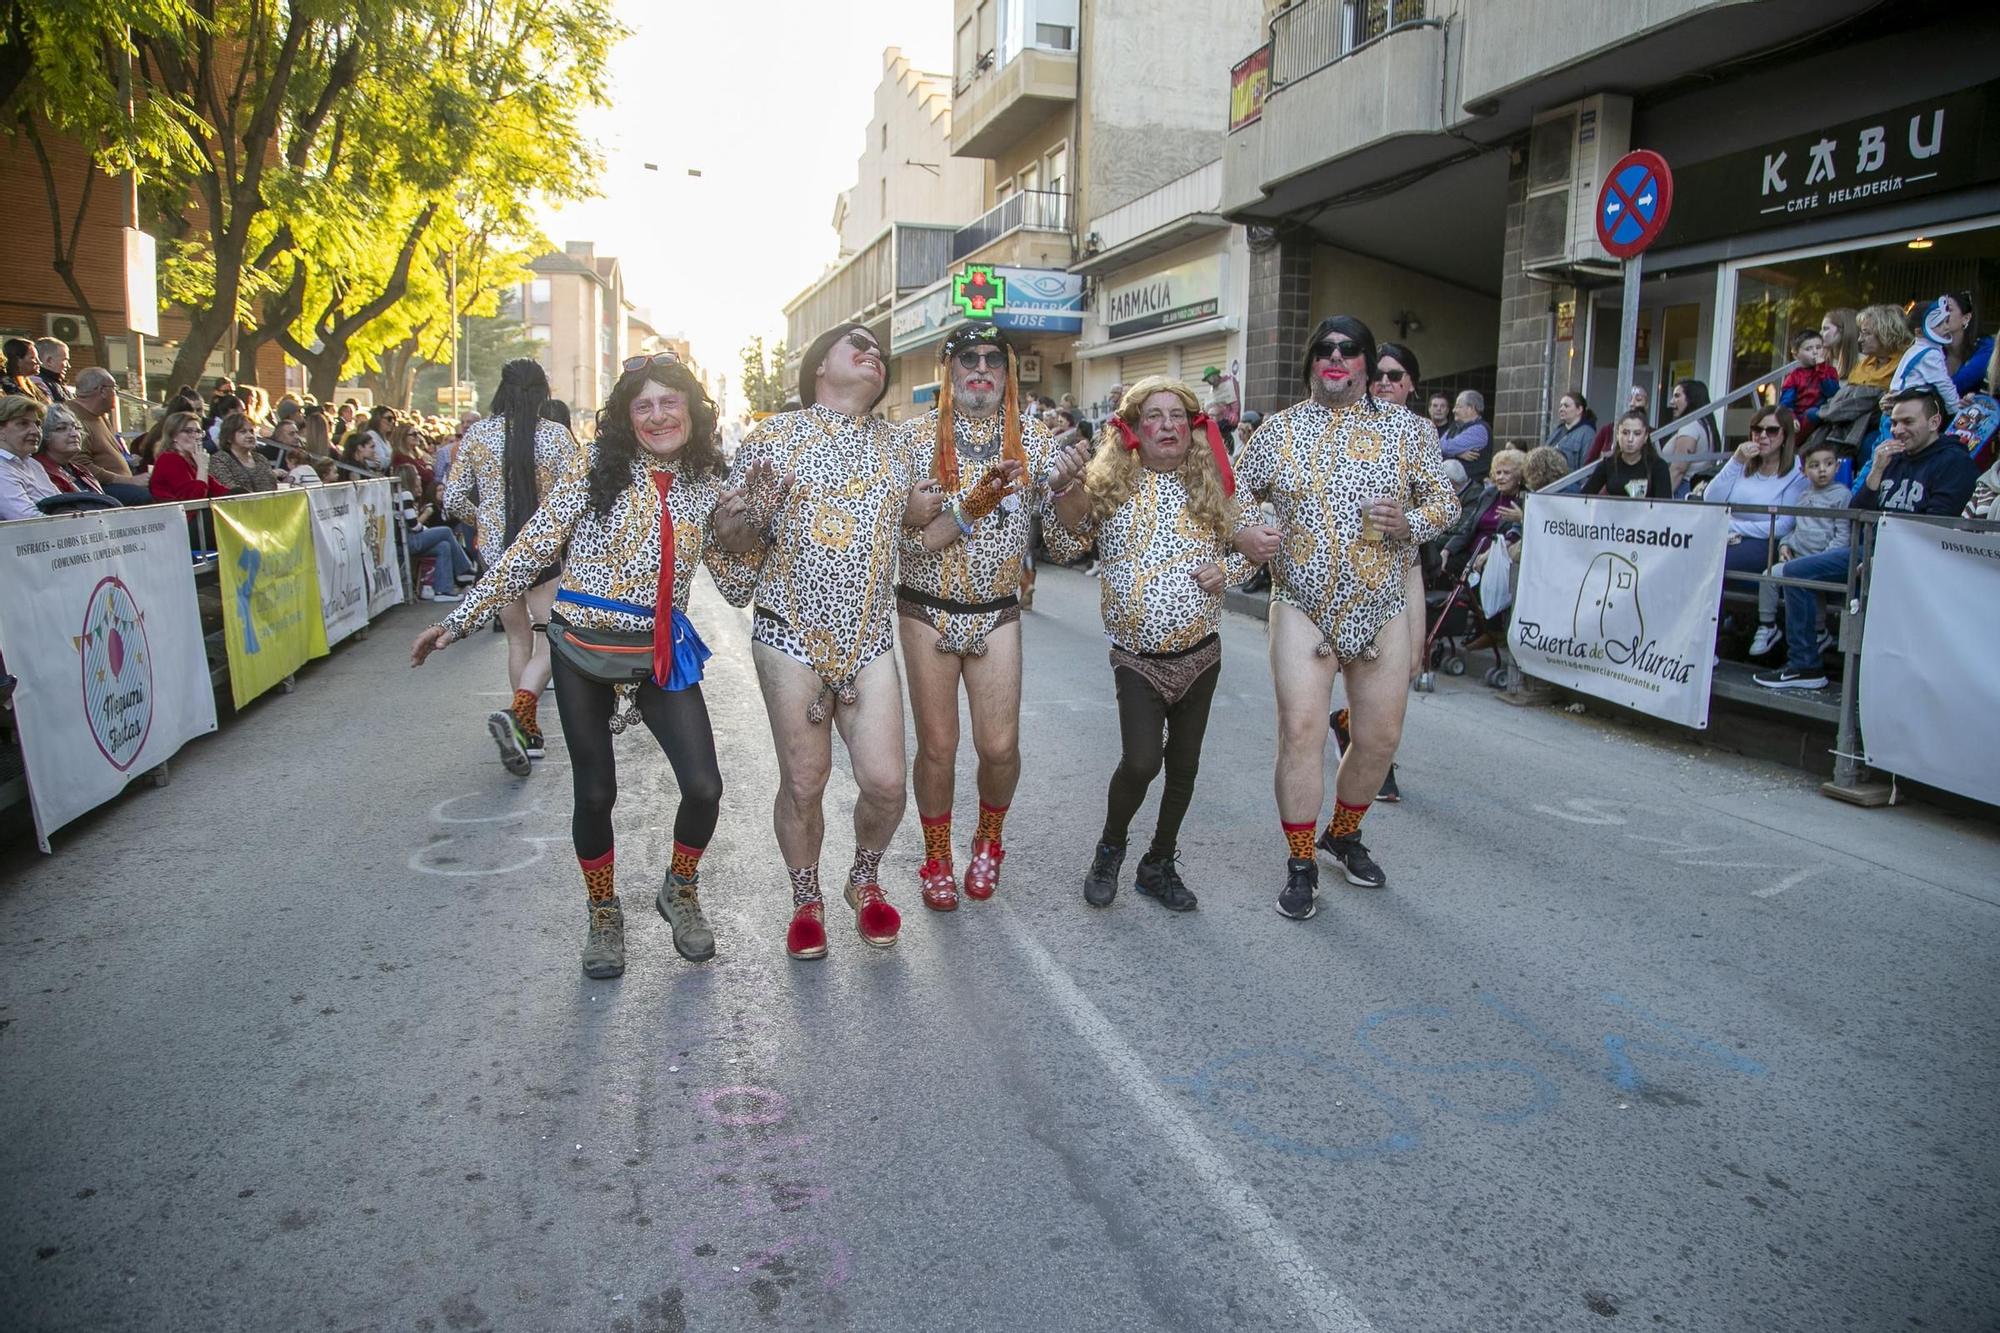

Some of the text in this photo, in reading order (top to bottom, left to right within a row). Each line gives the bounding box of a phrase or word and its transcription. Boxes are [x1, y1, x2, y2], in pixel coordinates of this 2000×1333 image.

[1761, 108, 1945, 196] KABU
[1787, 175, 1903, 213] CAFÉ HELADERÍA
[1111, 280, 1171, 321] FARMACIA
[1879, 478, 1925, 512] GAP
[16, 541, 51, 557] DISFRACES
[57, 535, 80, 550] GLOBOS
[1518, 617, 1695, 684] Puerta de Murcia
